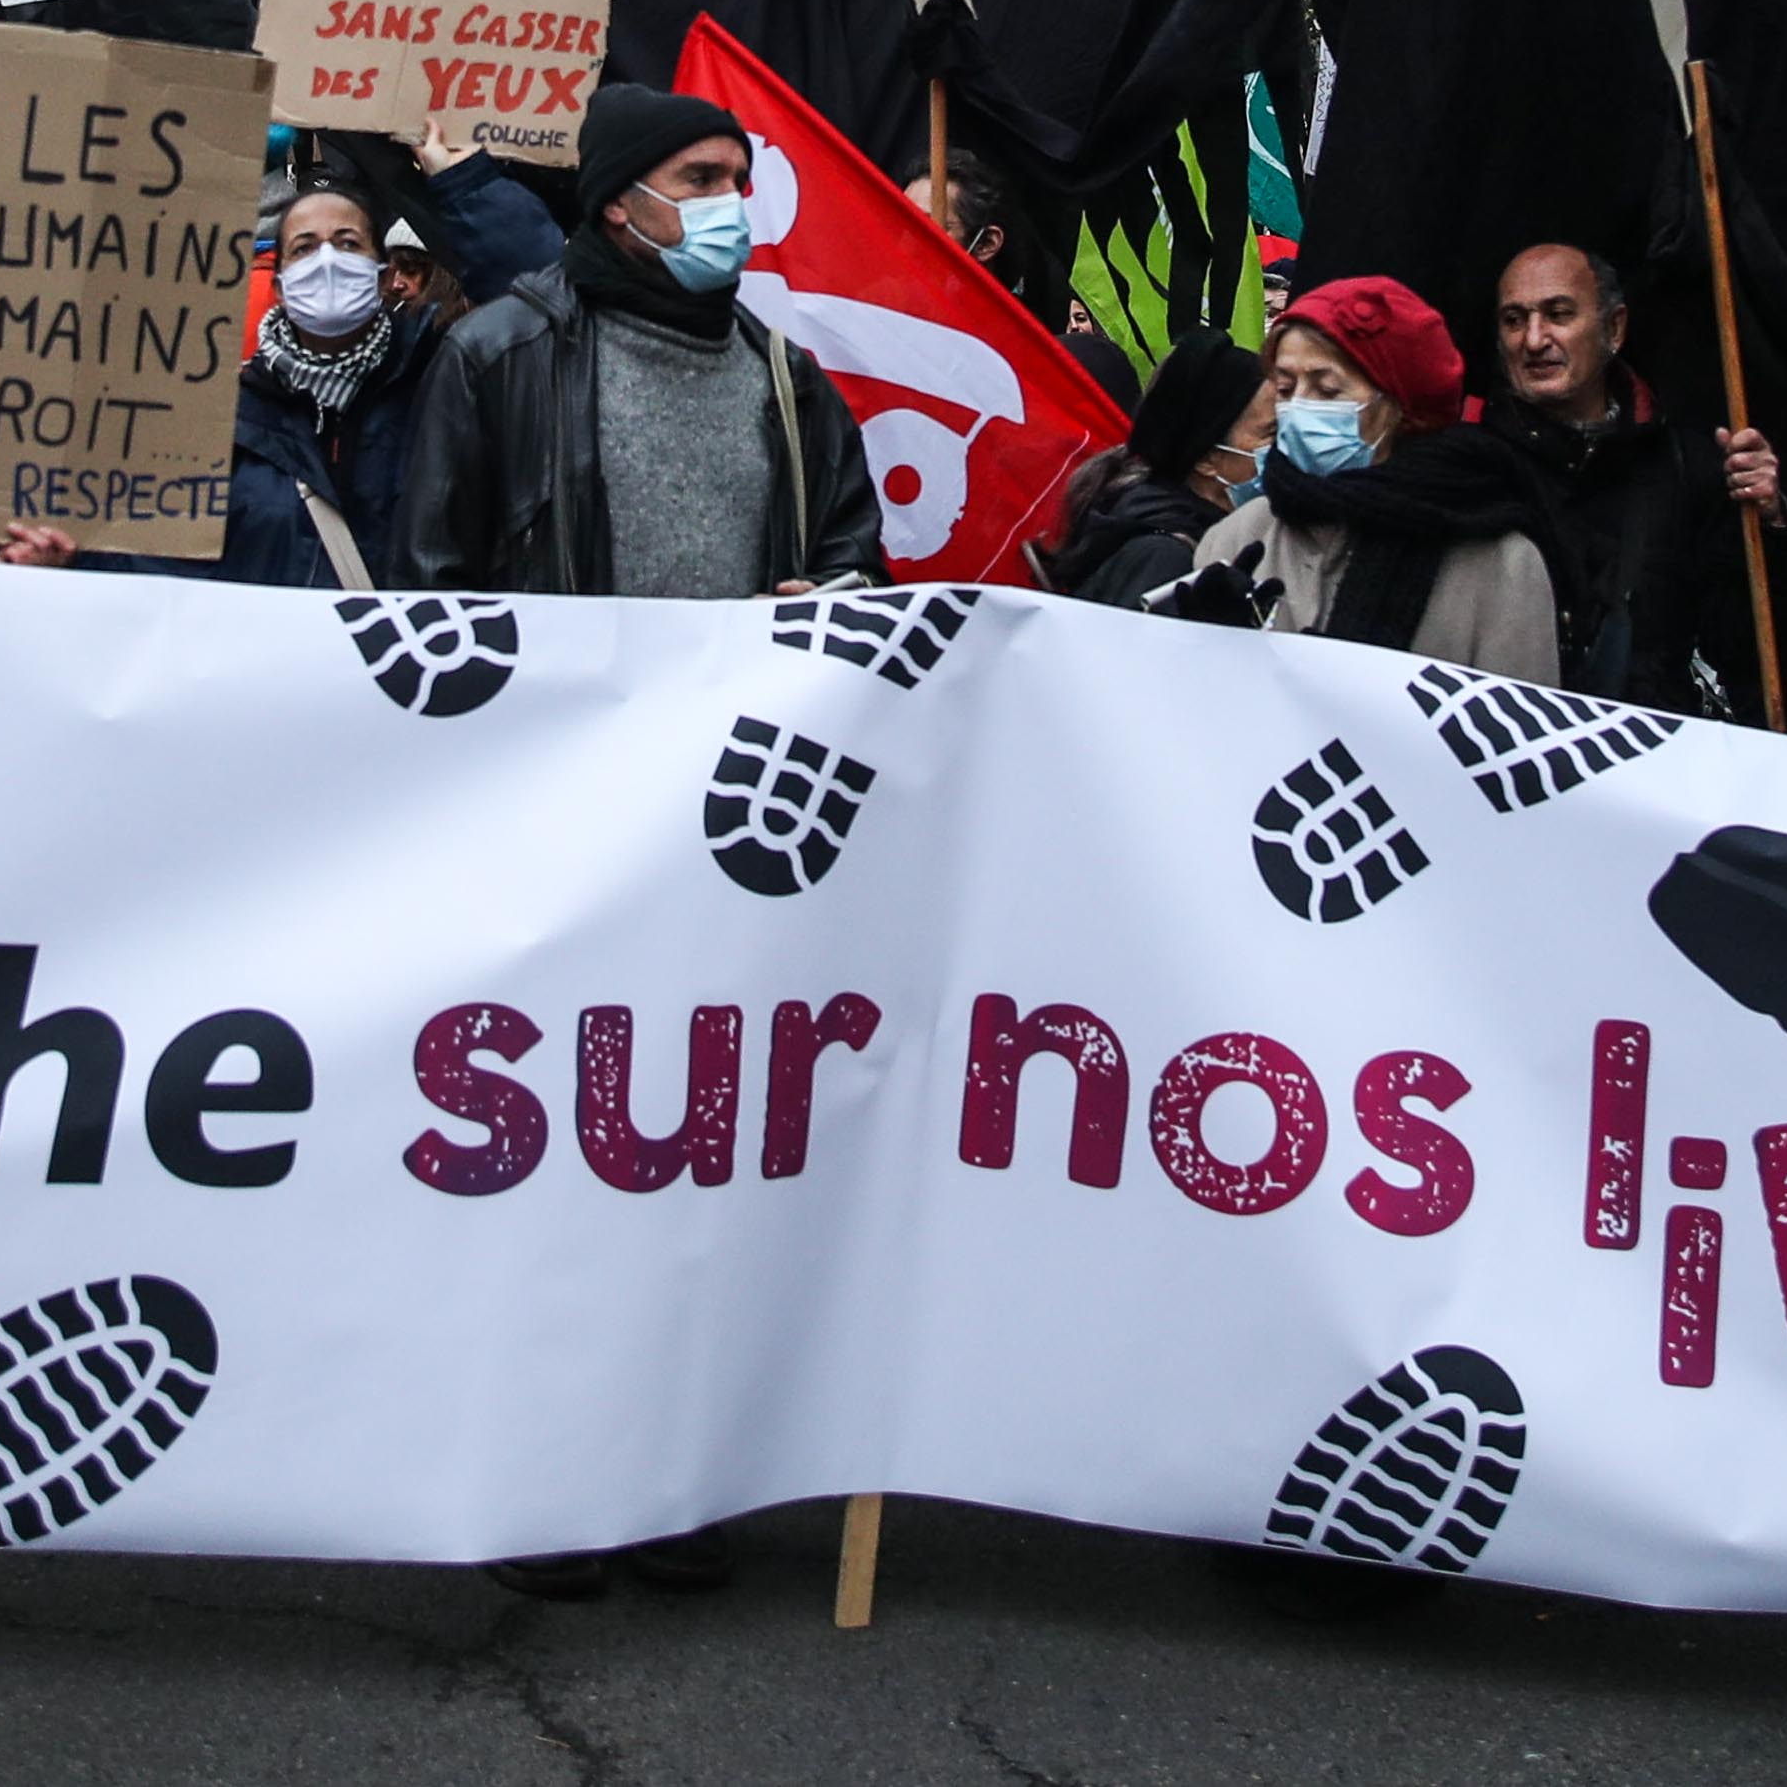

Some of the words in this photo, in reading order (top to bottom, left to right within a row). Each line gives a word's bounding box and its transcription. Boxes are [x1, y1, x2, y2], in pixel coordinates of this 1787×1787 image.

[315, 0, 443, 45] SANS
[452, 4, 603, 56] CASSER
[310, 66, 380, 101] DES
[19, 93, 188, 199] LES
[471, 121, 569, 149] COLUCHE
[11, 457, 231, 522] RESPECTÉ
[400, 989, 884, 1198] sur
[958, 990, 1476, 1239] nos
